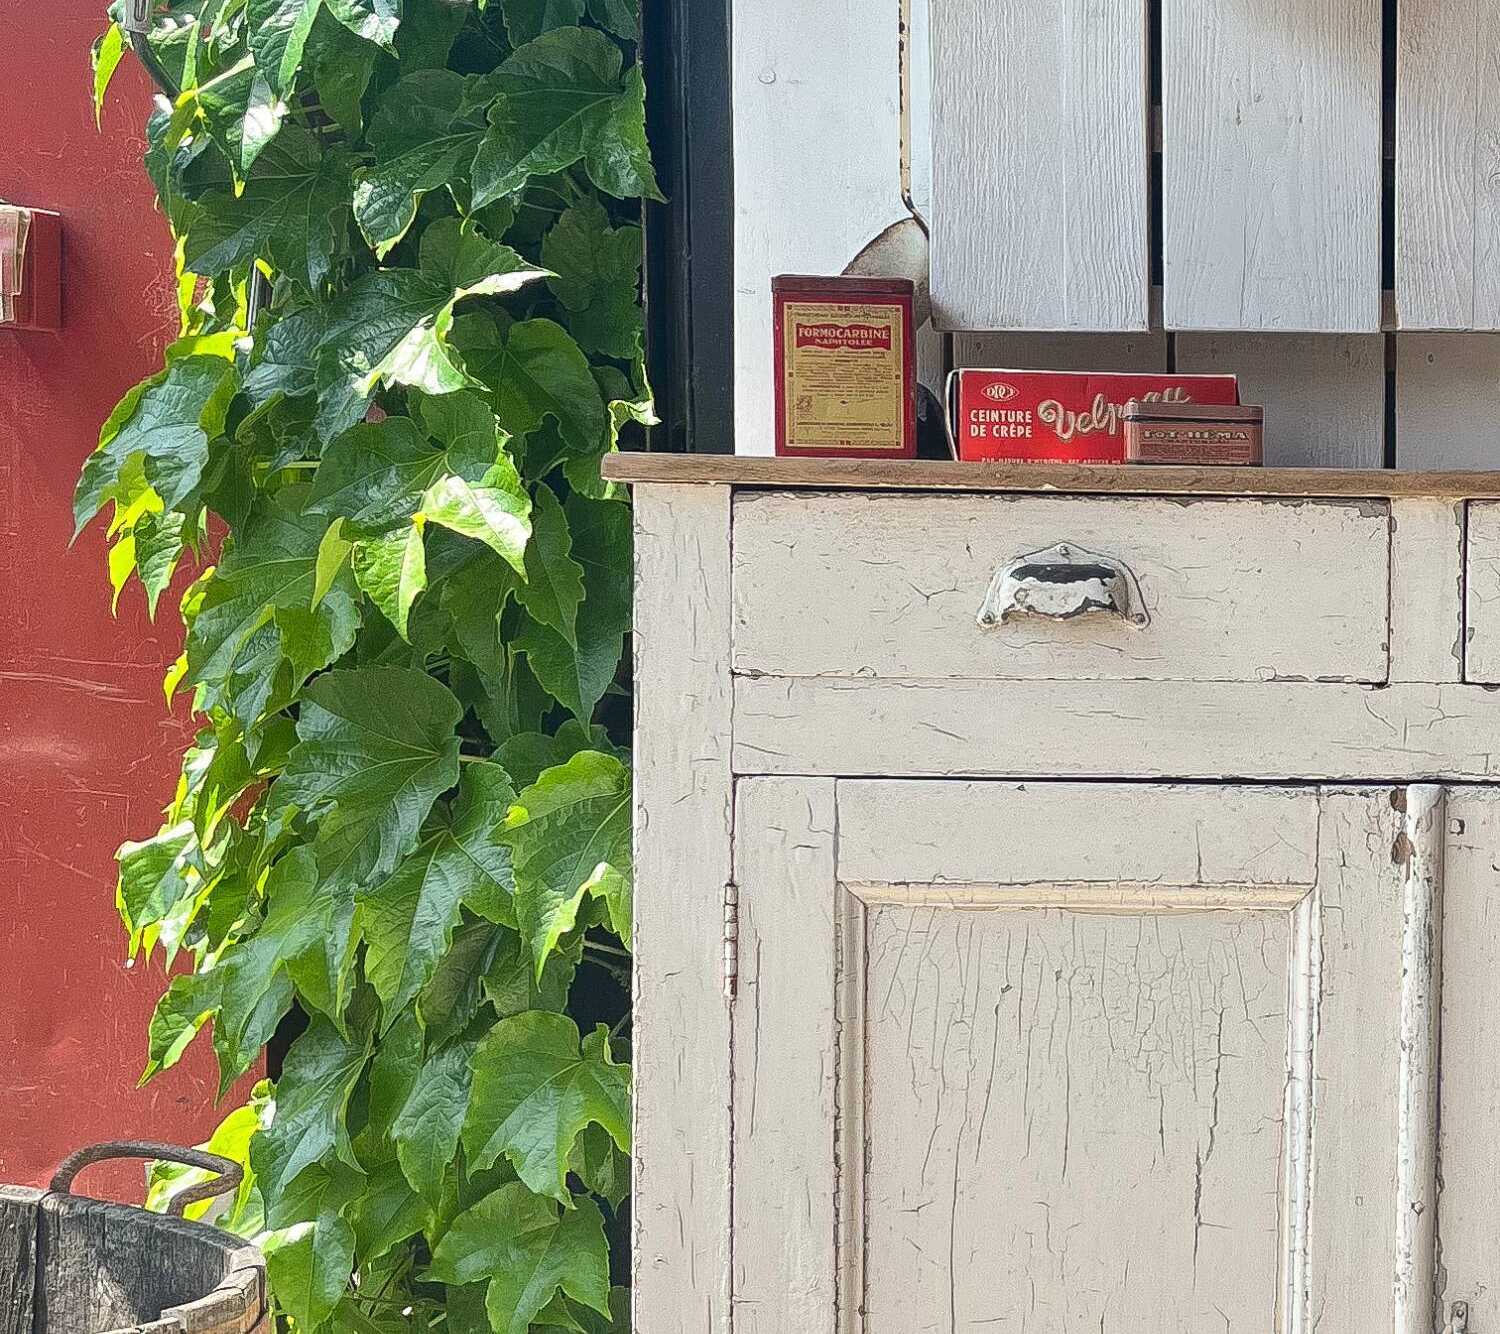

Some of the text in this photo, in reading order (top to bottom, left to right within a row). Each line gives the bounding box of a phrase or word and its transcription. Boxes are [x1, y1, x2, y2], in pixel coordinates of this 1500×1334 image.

[797, 327, 890, 340] FORMOCARBINE
[970, 408, 1033, 423] CEINTURE
[970, 421, 1033, 439] DE CRÊPE
